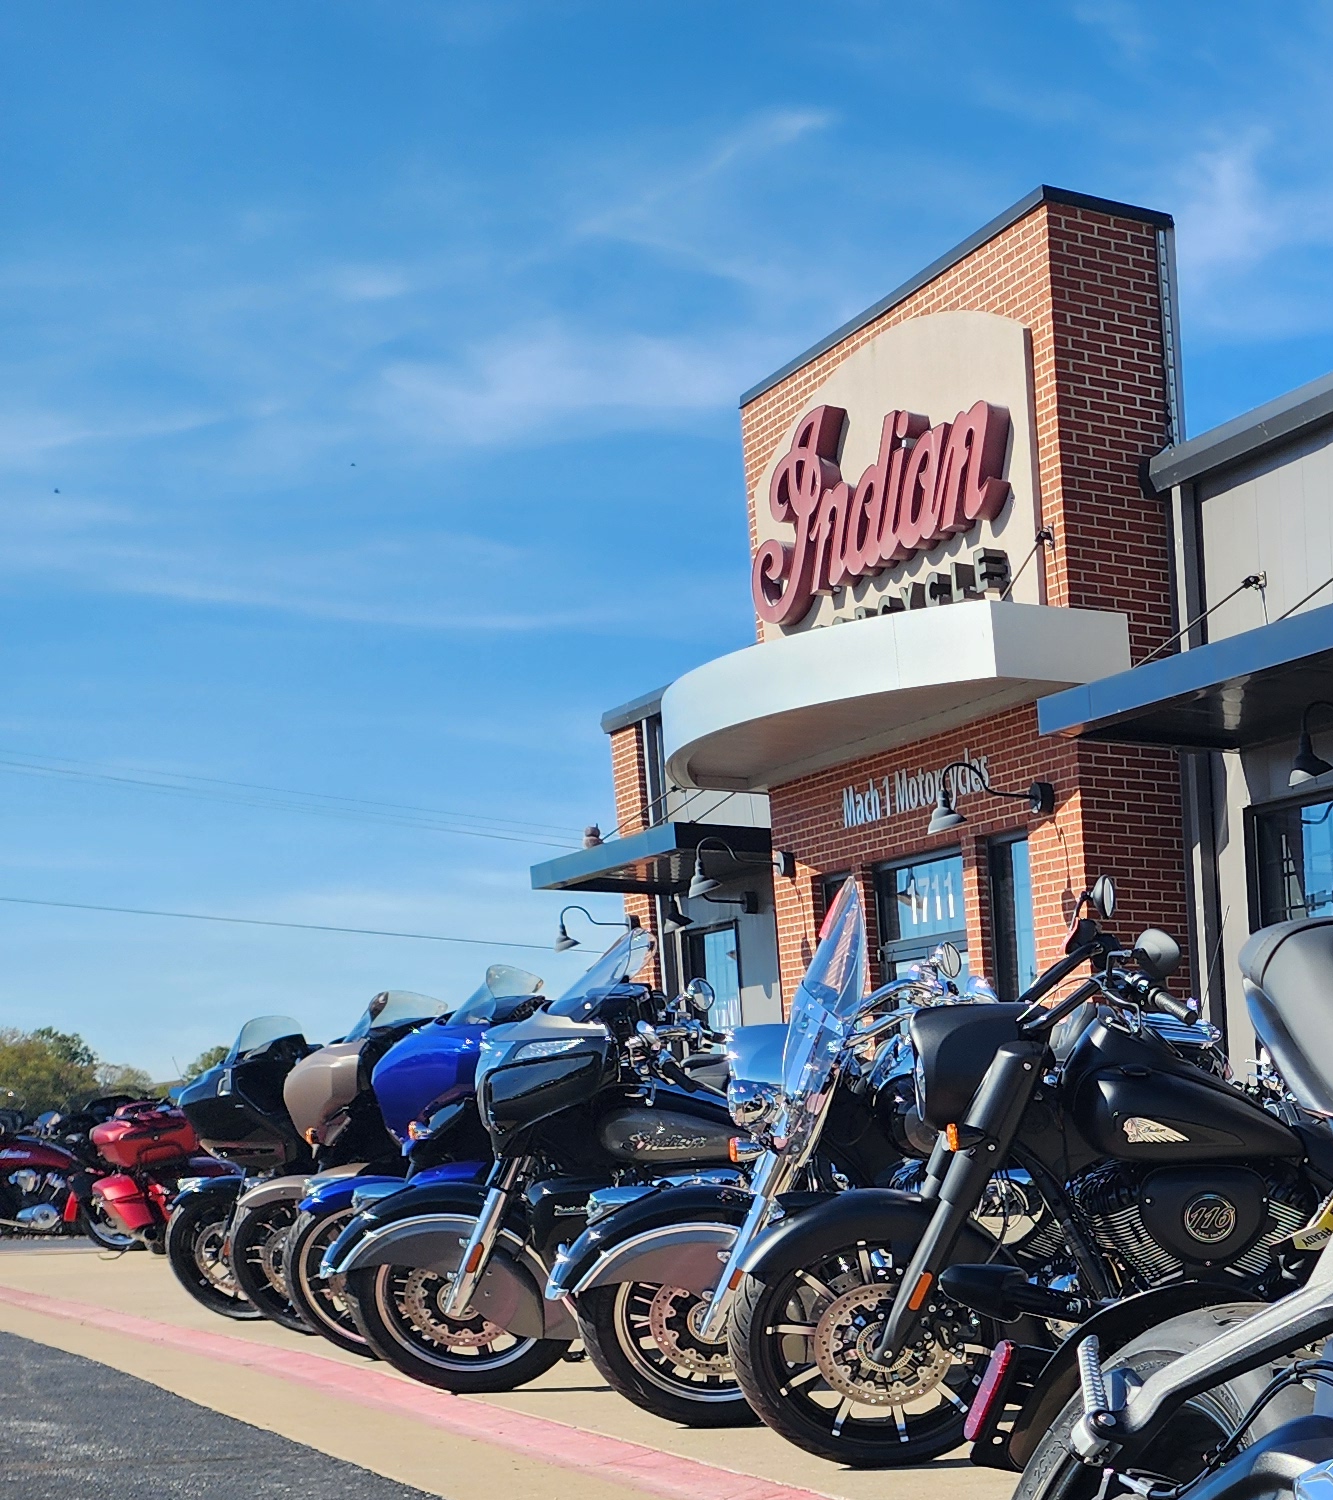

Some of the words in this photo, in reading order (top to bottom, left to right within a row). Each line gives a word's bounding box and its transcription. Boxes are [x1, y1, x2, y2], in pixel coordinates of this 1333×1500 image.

[752, 400, 1011, 625] Indian
[843, 785, 881, 829] Mach
[882, 776, 891, 817] 1
[894, 747, 990, 814] Motorycles
[907, 871, 955, 925] 1711
[1188, 1206, 1235, 1229] 116
[1301, 1226, 1333, 1248] READY
